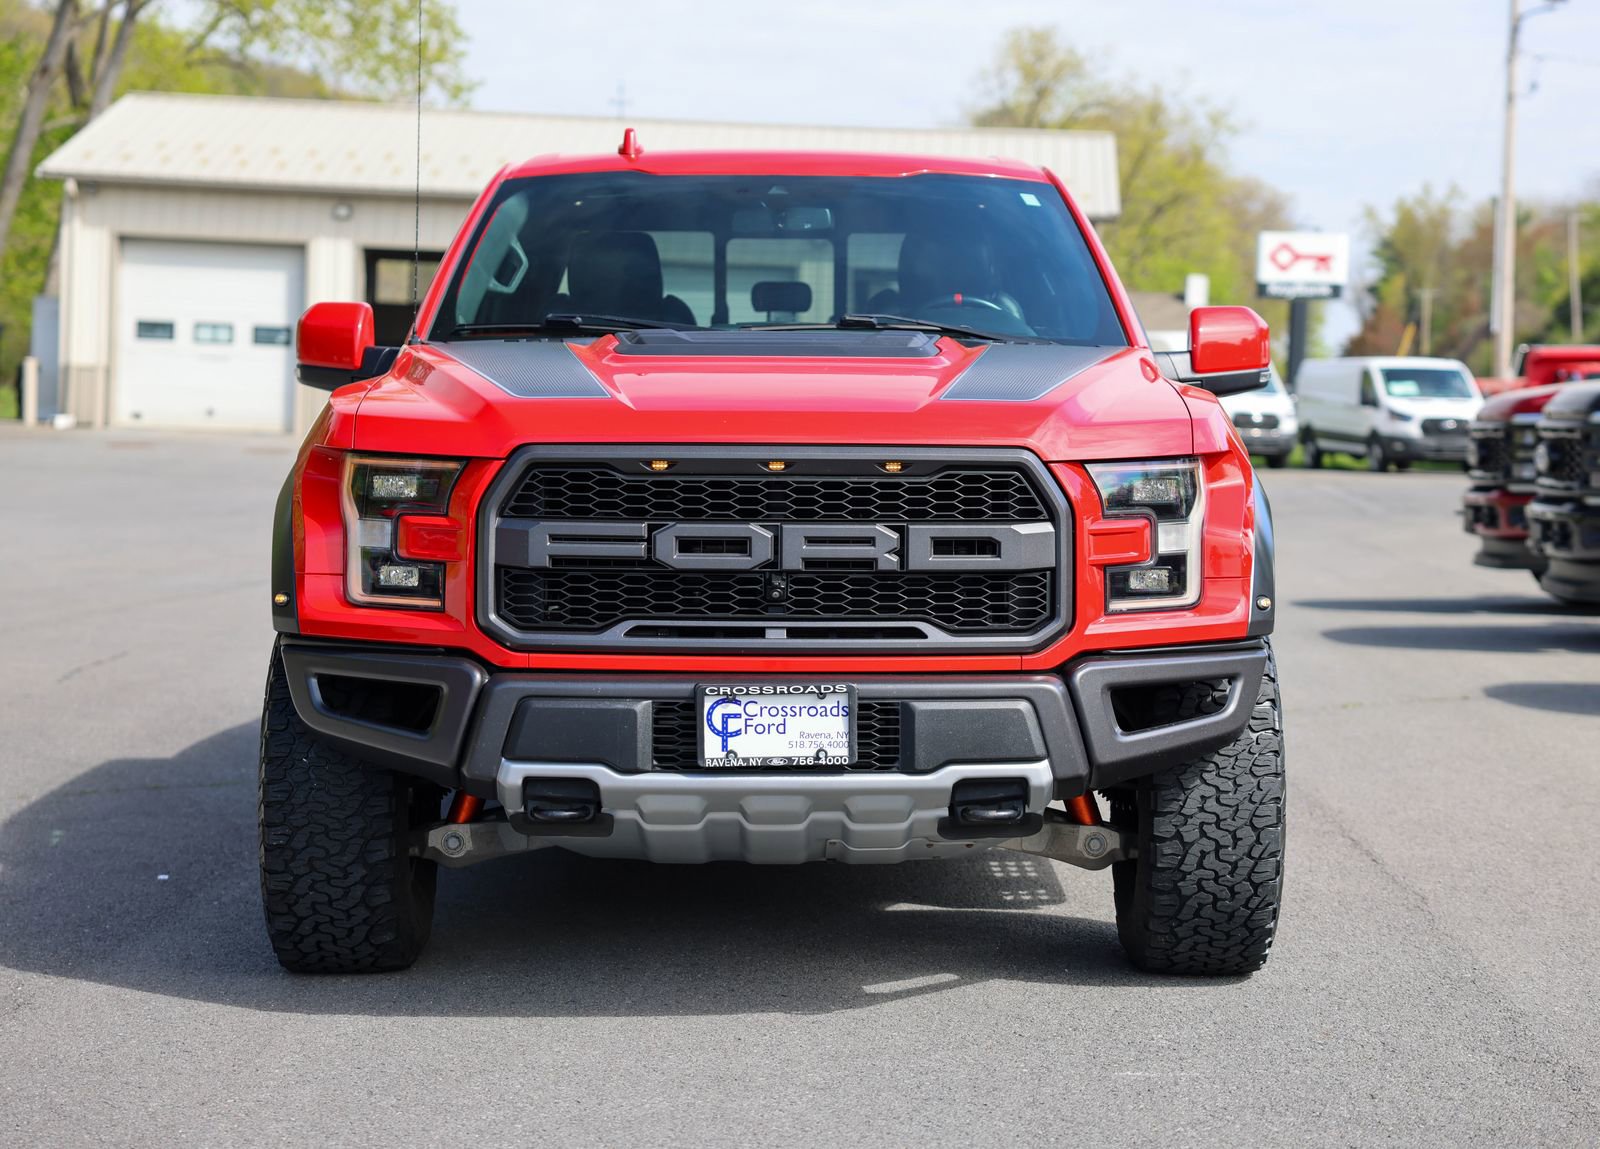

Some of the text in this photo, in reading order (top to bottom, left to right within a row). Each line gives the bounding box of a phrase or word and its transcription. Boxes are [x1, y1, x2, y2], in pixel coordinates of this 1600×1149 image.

[495, 520, 1055, 571] FORD
[705, 685, 847, 695] CROSSROADS
[743, 700, 849, 717] Crossroads
[744, 718, 786, 734] Ford
[799, 731, 849, 740] Ravena, NY
[788, 740, 849, 749] 518.756.4000
[705, 758, 747, 767] RAVENA,
[749, 757, 763, 766] NY
[791, 756, 849, 765] 756-4000
